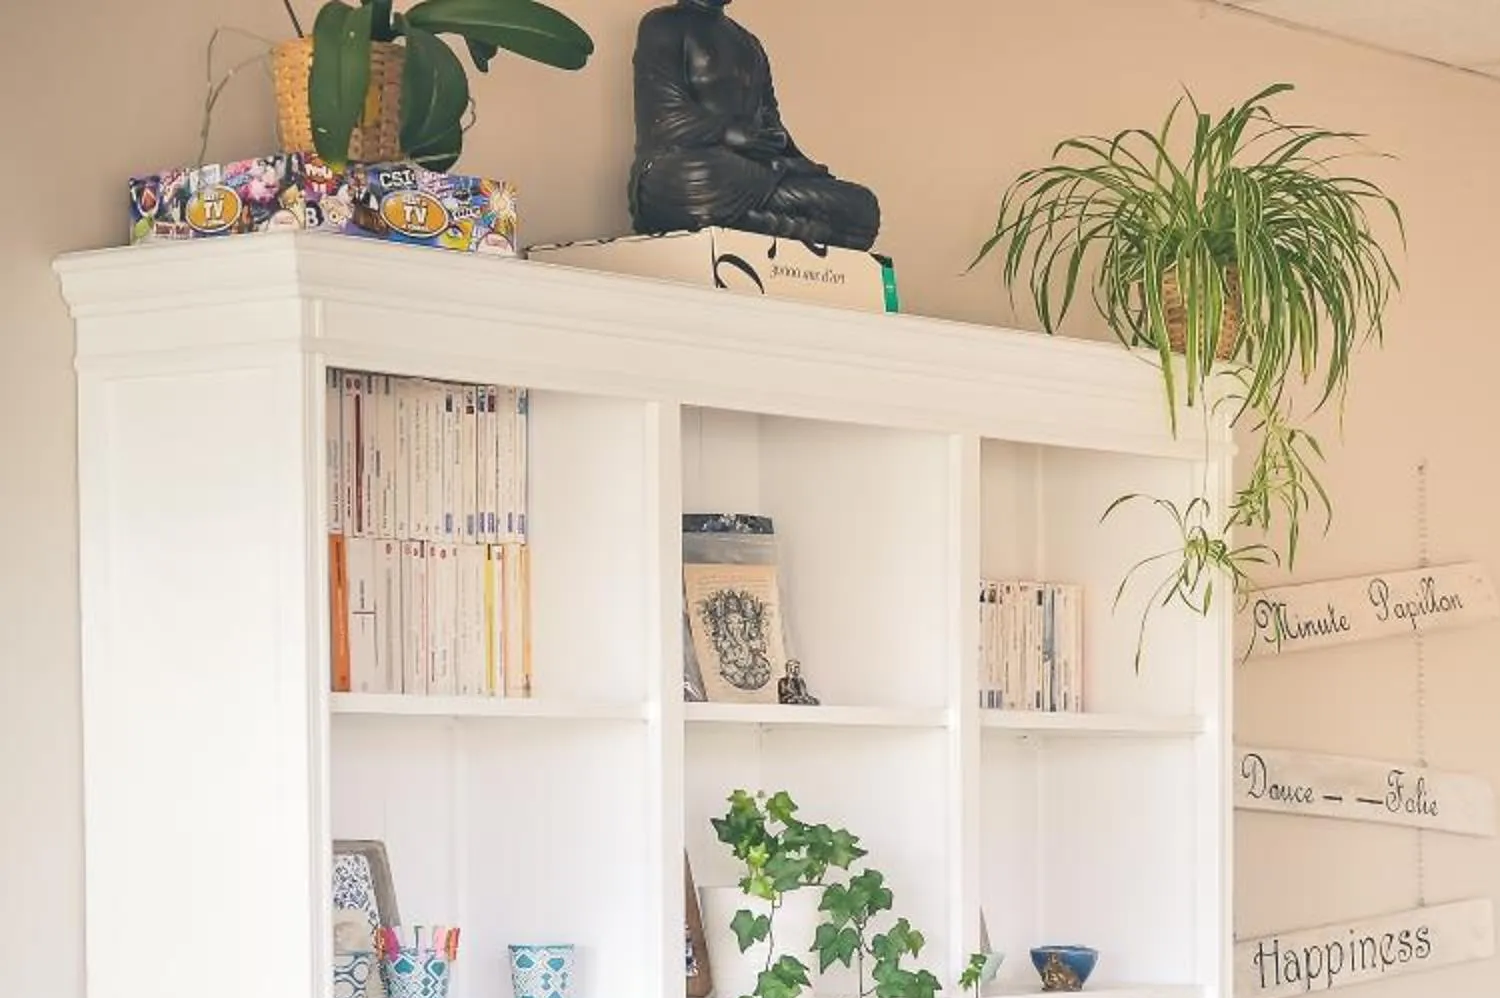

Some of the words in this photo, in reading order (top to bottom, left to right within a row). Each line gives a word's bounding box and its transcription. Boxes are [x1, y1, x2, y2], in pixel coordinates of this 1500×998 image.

[403, 204, 427, 224] TV
[1253, 598, 1351, 641] Minute
[1369, 576, 1464, 630] Papillon
[1241, 753, 1315, 803] Douce
[1385, 769, 1439, 816] Folie
[1253, 925, 1432, 990] Happiness
